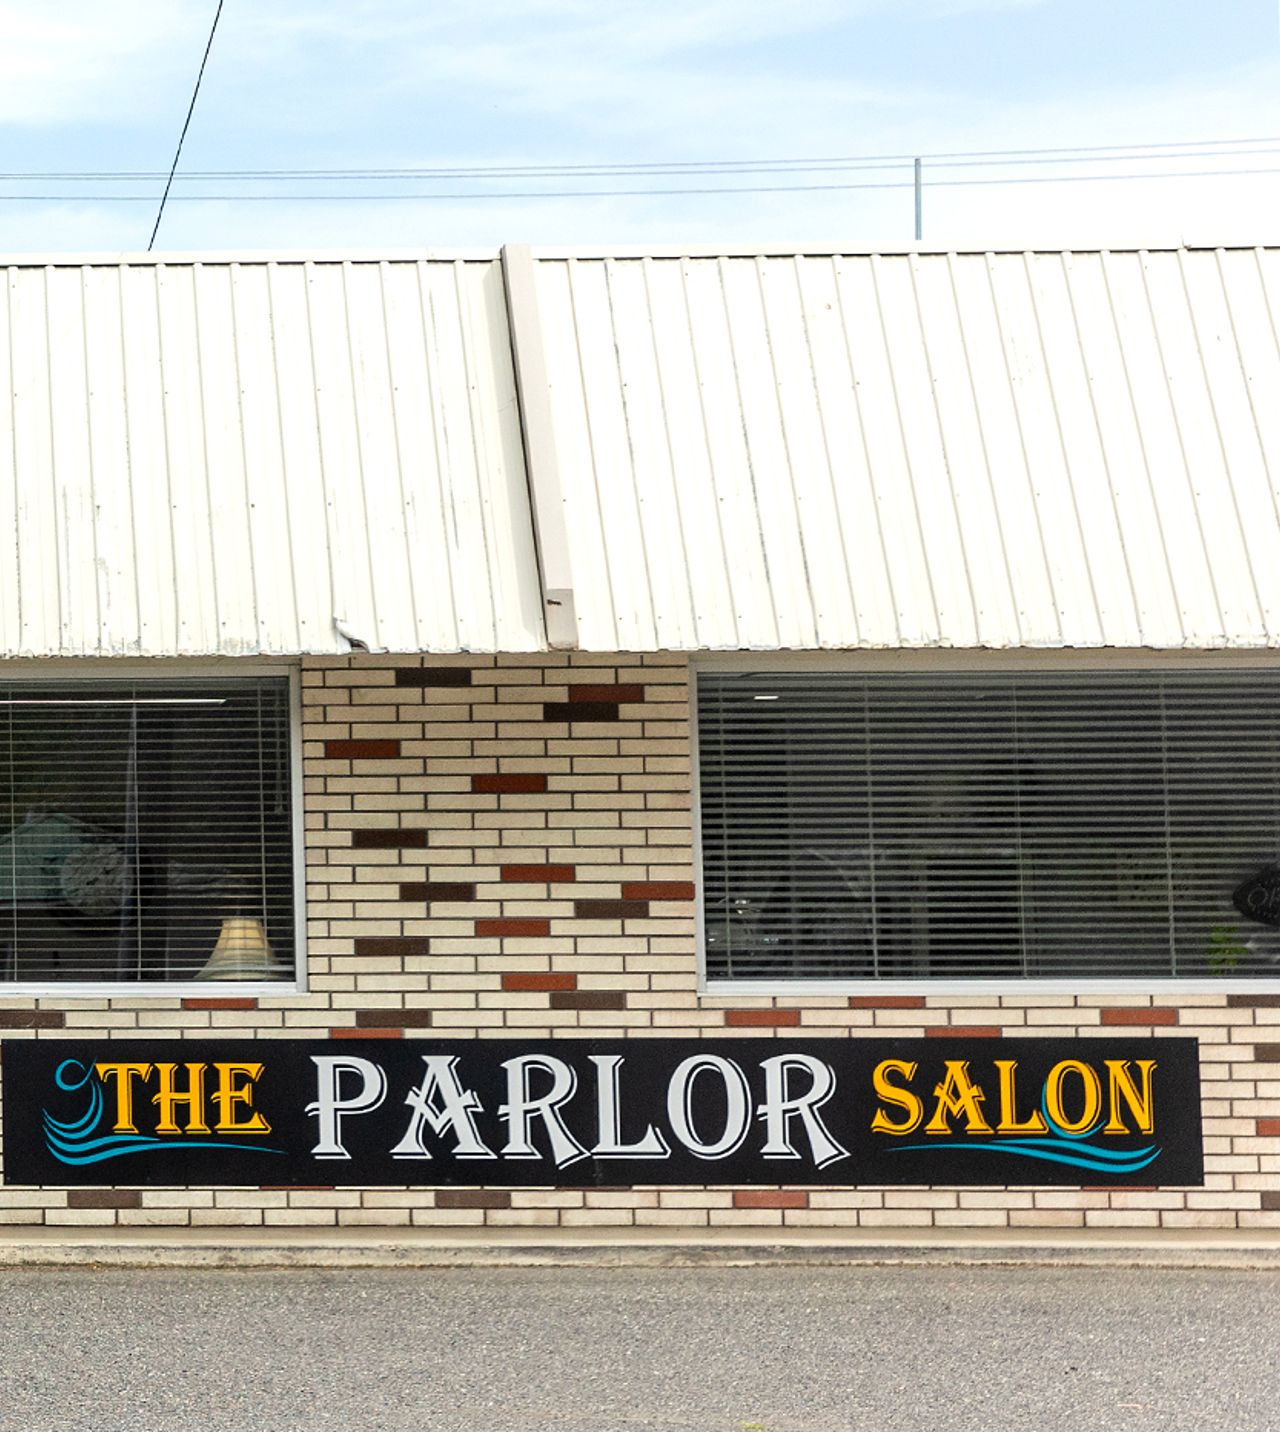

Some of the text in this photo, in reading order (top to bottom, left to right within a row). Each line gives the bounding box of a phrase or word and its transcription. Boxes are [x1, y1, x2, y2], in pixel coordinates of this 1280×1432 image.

[95, 1053, 1158, 1170] THE PARLOR SALON
